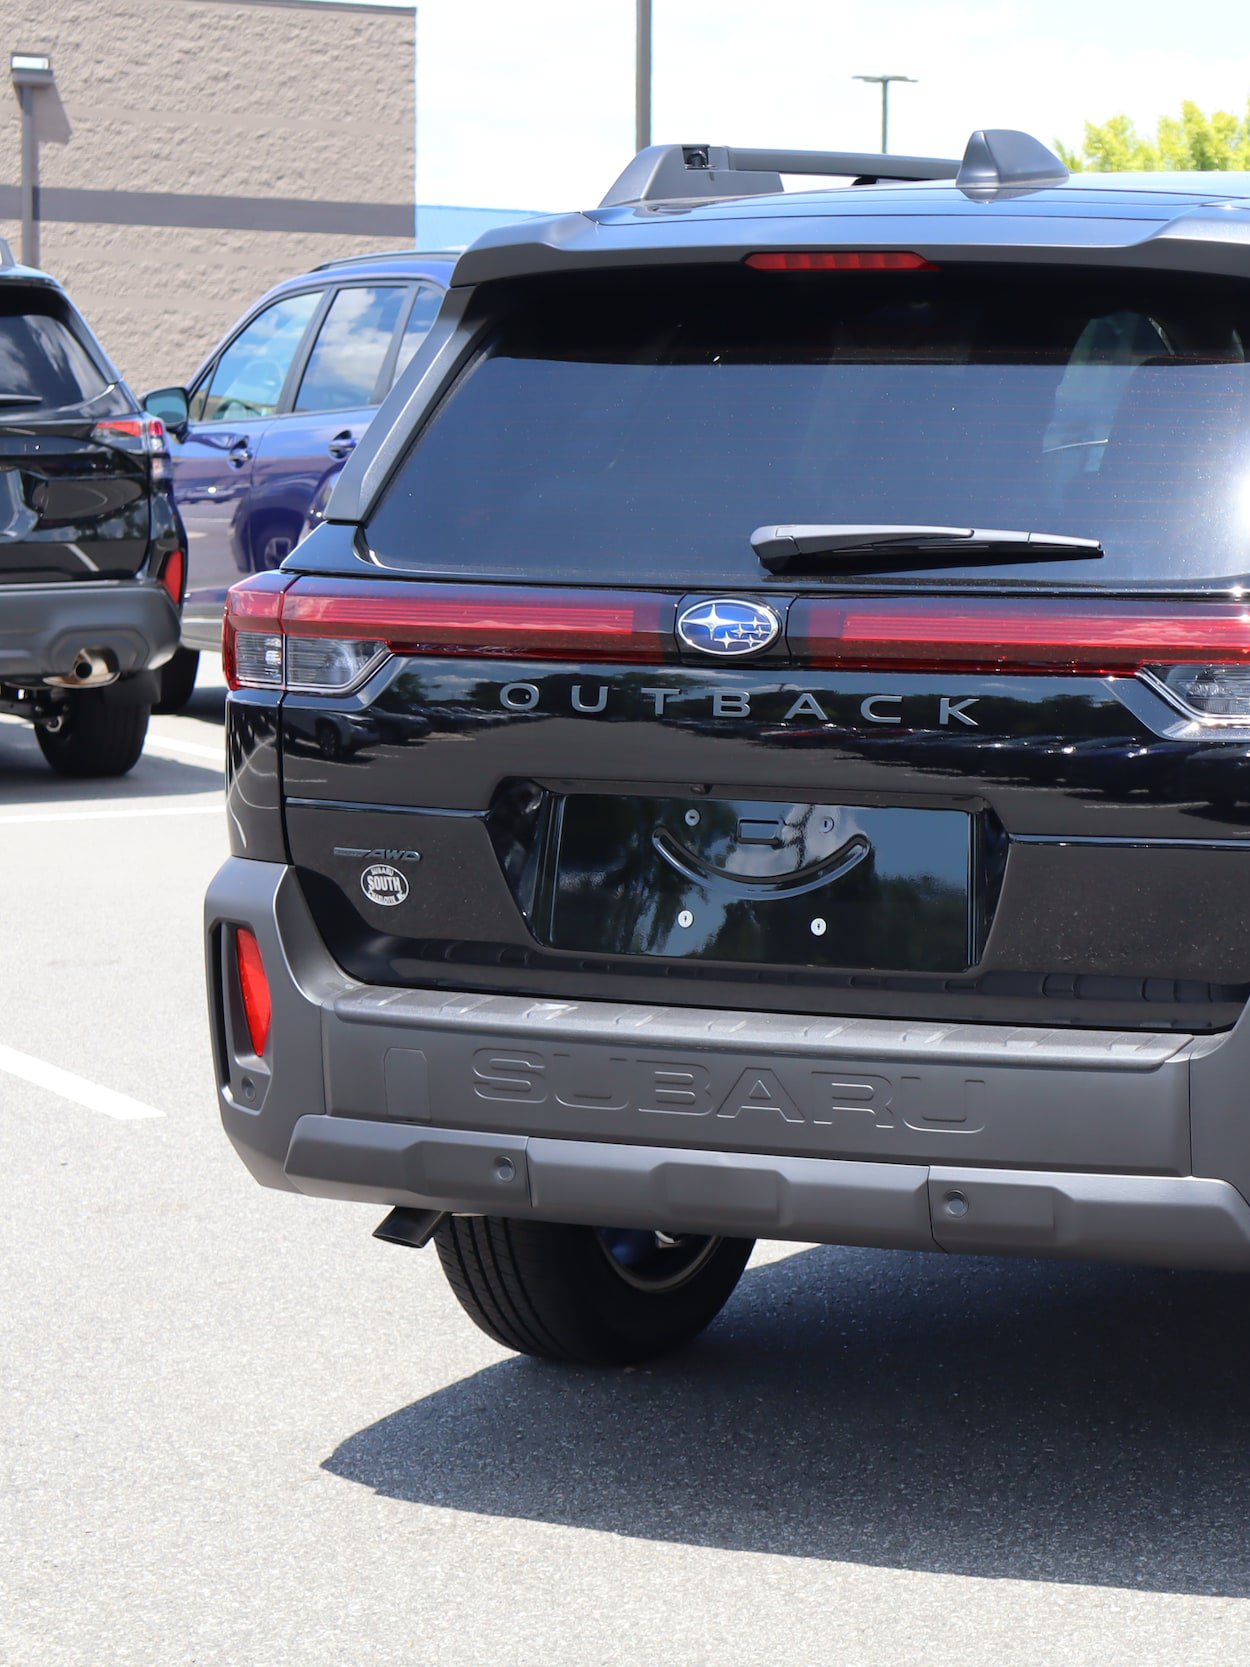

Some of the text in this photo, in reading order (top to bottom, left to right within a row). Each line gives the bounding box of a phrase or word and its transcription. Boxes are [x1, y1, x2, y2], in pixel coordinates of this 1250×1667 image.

[500, 682, 980, 726] OUTBACK
[364, 848, 421, 862] AWD
[366, 875, 401, 892] SOUTH
[472, 1047, 986, 1133] SUBARU
